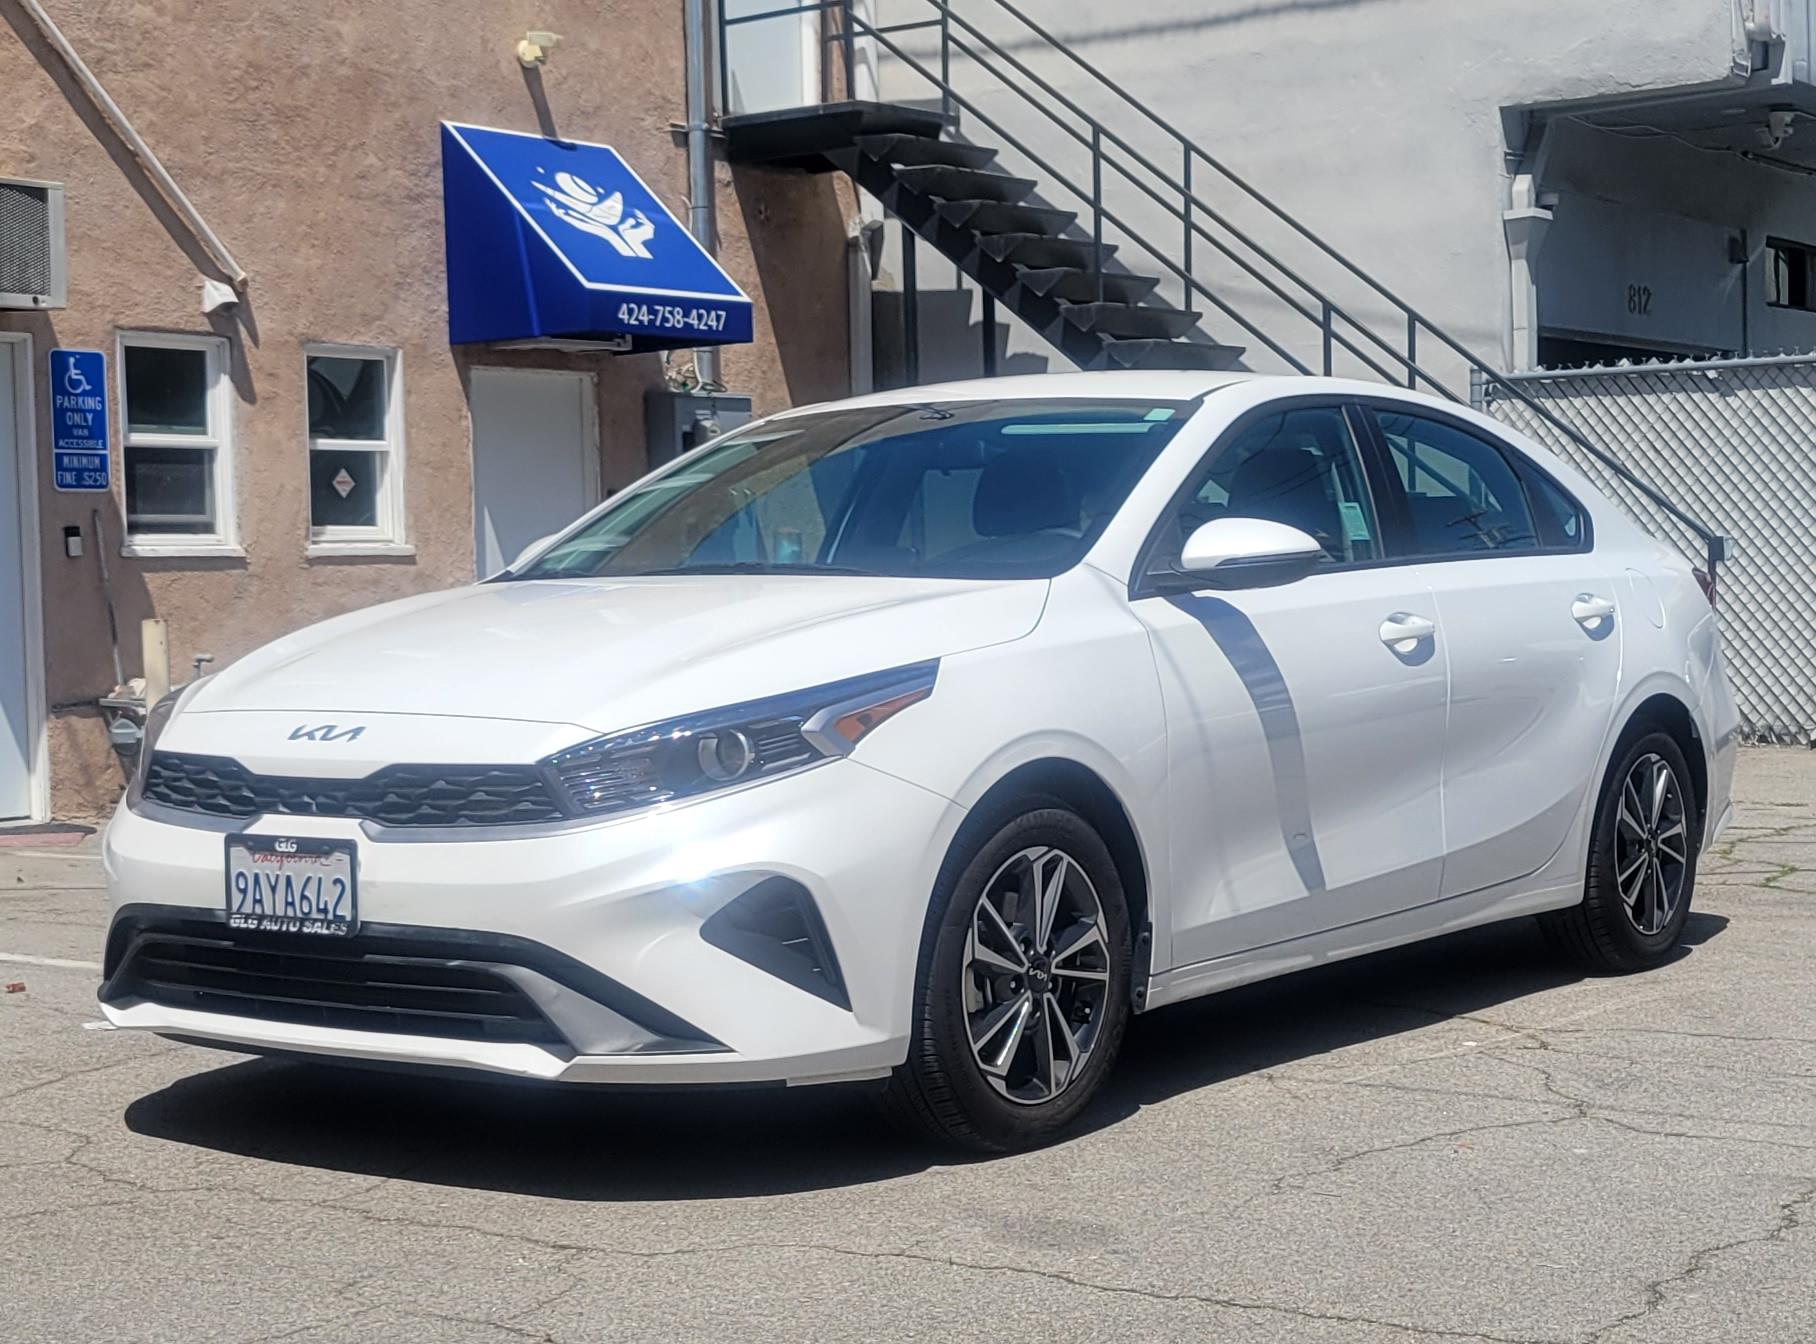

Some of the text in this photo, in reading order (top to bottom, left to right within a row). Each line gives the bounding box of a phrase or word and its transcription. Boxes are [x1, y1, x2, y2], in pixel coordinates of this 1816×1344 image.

[1627, 284, 1652, 316] 812
[618, 303, 727, 332] 424-758-4247
[56, 395, 102, 410] PARKING
[66, 412, 94, 426] ONLY
[72, 428, 89, 437] VAN
[58, 439, 104, 449] ACCESSIBLE
[63, 455, 101, 469] MINIMUM
[57, 471, 77, 485] FINE
[287, 724, 367, 743] KIA
[274, 838, 298, 853] GLG
[235, 870, 347, 922] 9AYA642
[230, 914, 348, 936] GLG AUTO SALES
